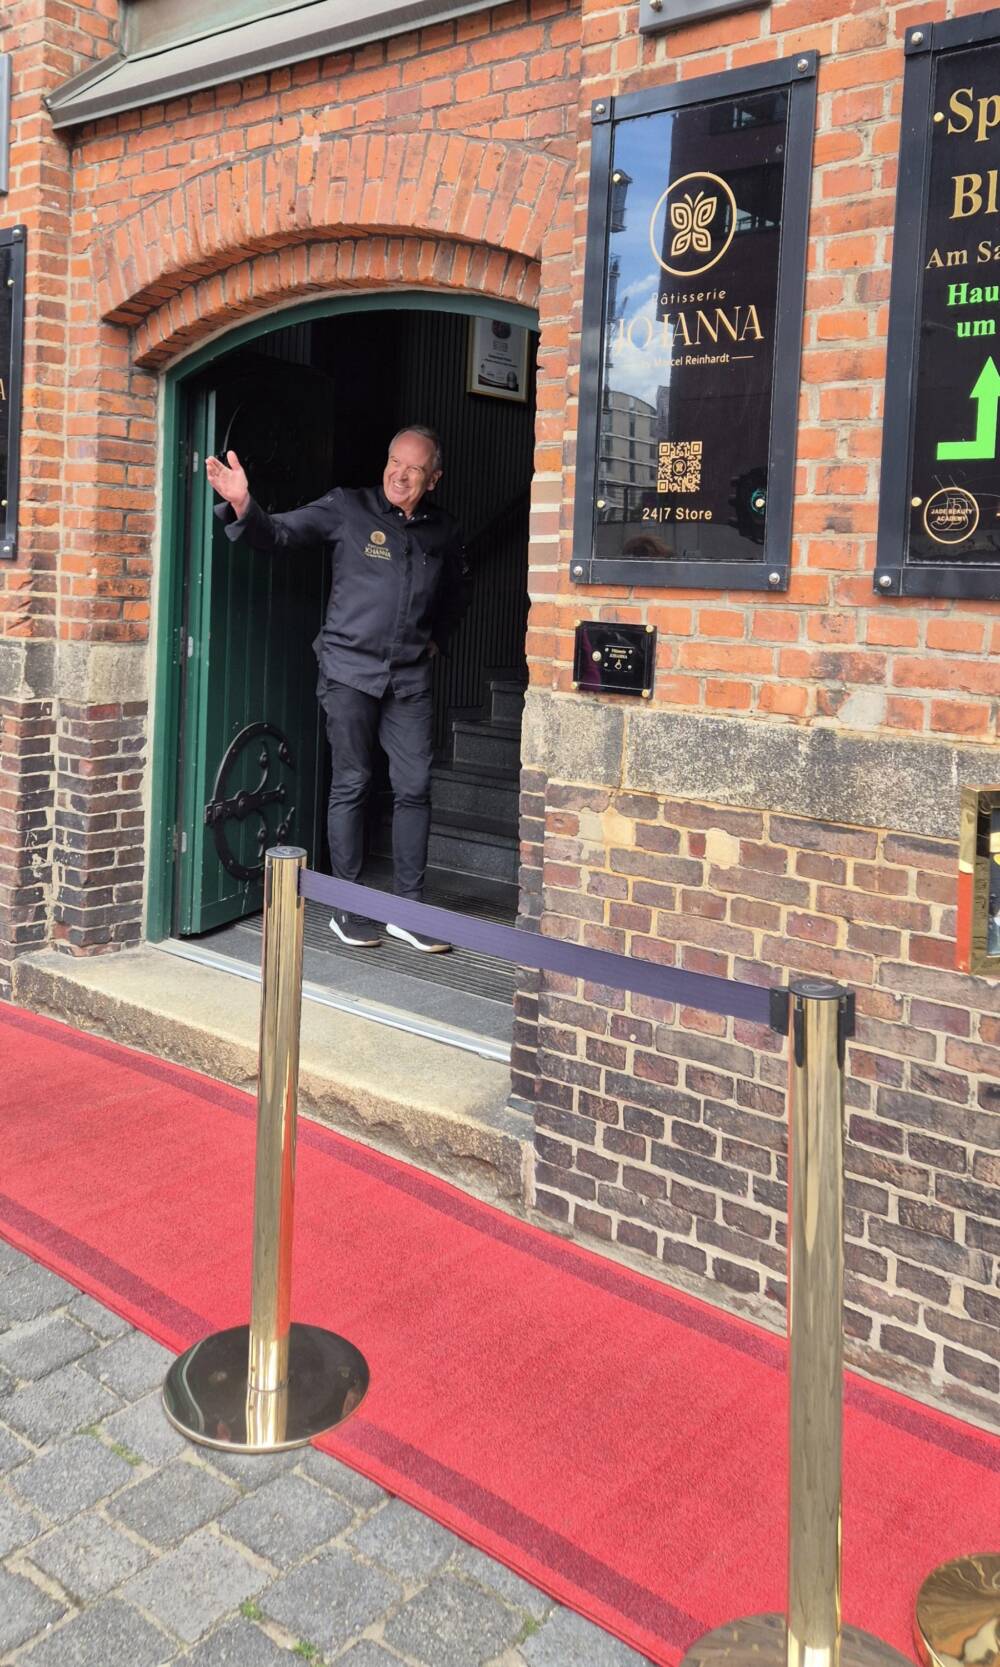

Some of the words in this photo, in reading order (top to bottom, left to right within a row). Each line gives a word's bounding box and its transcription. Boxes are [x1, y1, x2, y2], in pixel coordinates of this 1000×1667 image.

[949, 169, 999, 220] Bl
[925, 247, 968, 269] Am
[947, 282, 1000, 306] Hau
[957, 319, 996, 338] um
[685, 353, 730, 366] Reinhardt
[675, 507, 713, 520] Store
